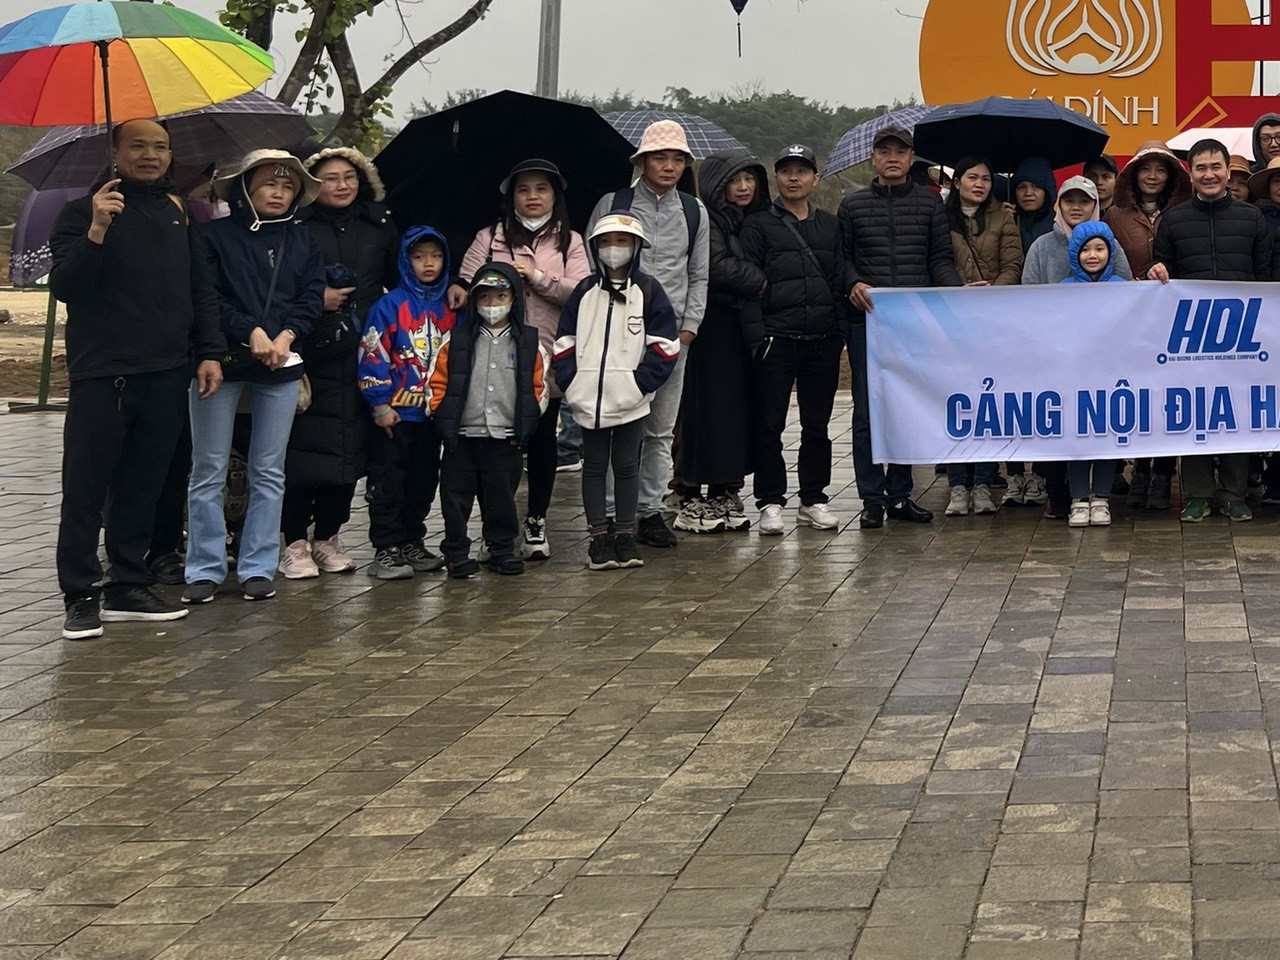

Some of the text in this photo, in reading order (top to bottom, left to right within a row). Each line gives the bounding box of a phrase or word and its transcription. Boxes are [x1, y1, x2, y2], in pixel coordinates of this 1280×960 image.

[1167, 297, 1262, 353] HDL
[946, 376, 1062, 437] CẢNG
[1076, 379, 1151, 444] NỘI
[1164, 385, 1237, 441] ĐỊA
